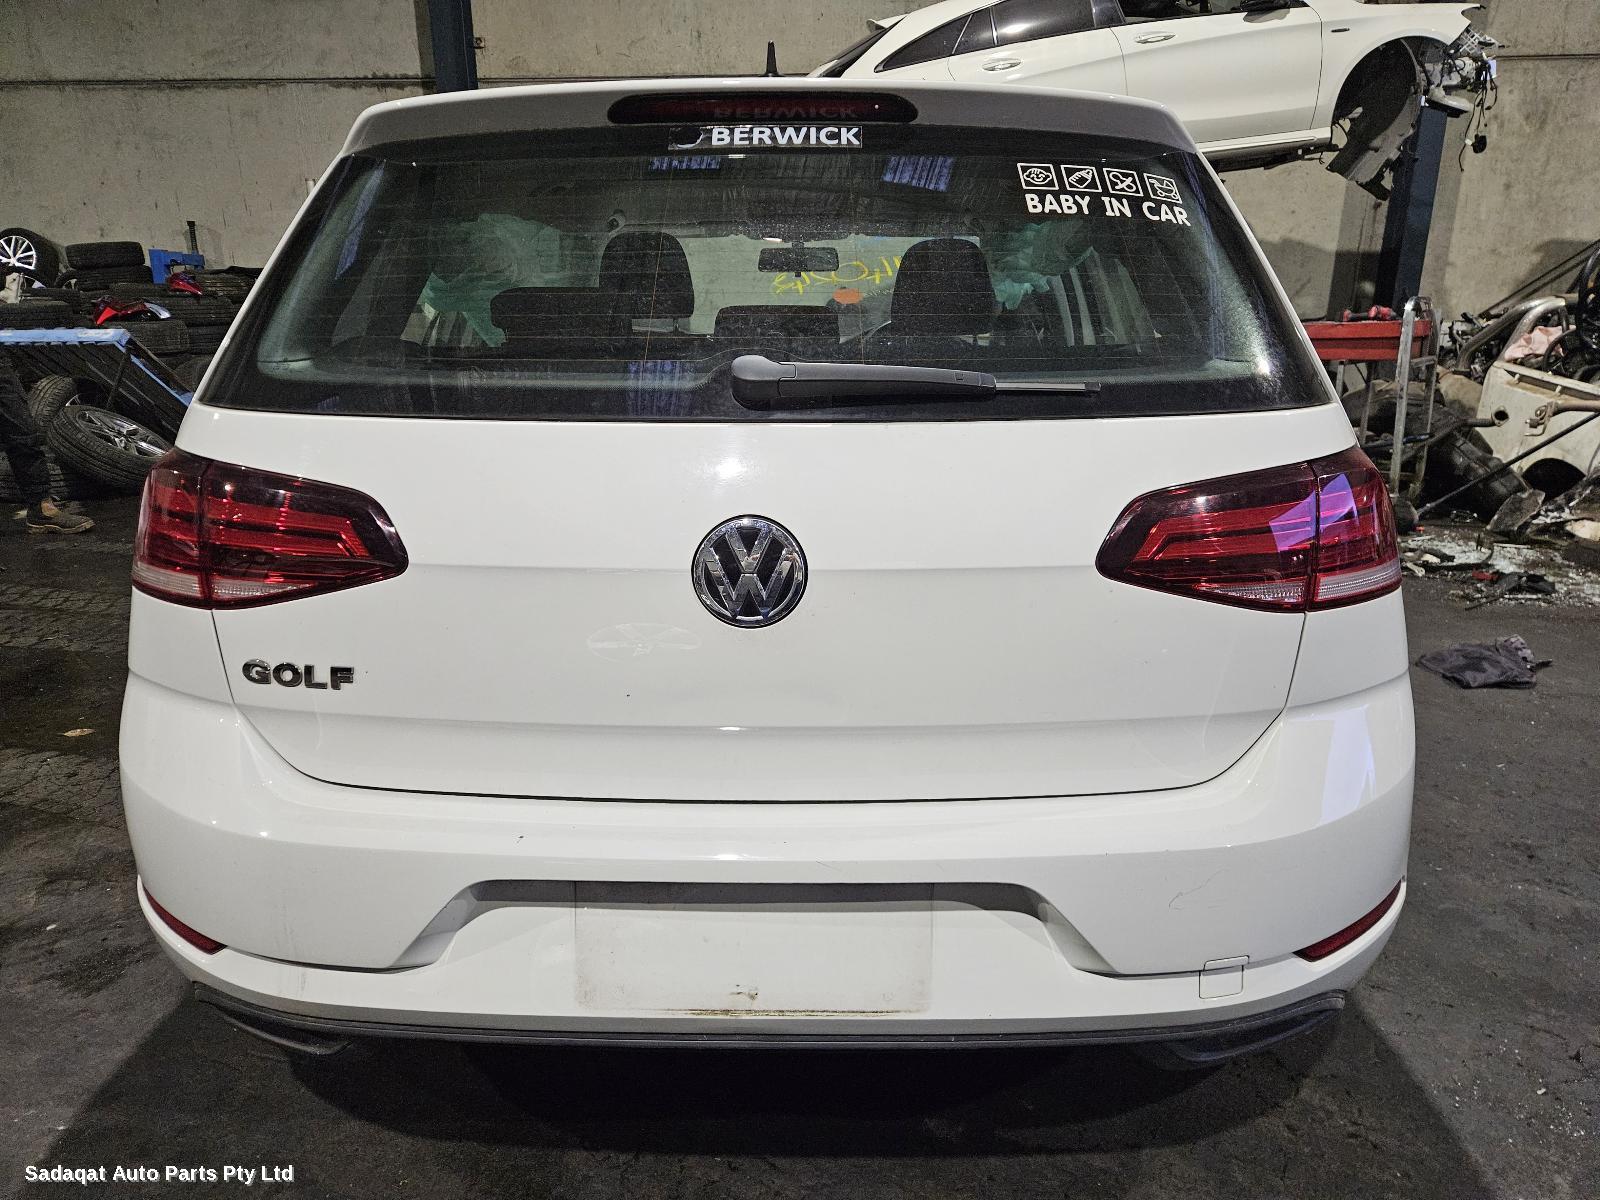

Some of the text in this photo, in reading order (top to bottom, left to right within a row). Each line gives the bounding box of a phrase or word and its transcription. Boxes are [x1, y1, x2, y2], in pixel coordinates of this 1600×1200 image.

[711, 127, 861, 146] BERWICK
[1025, 193, 1191, 226] BABY IN CAR
[242, 659, 355, 690] GOLF
